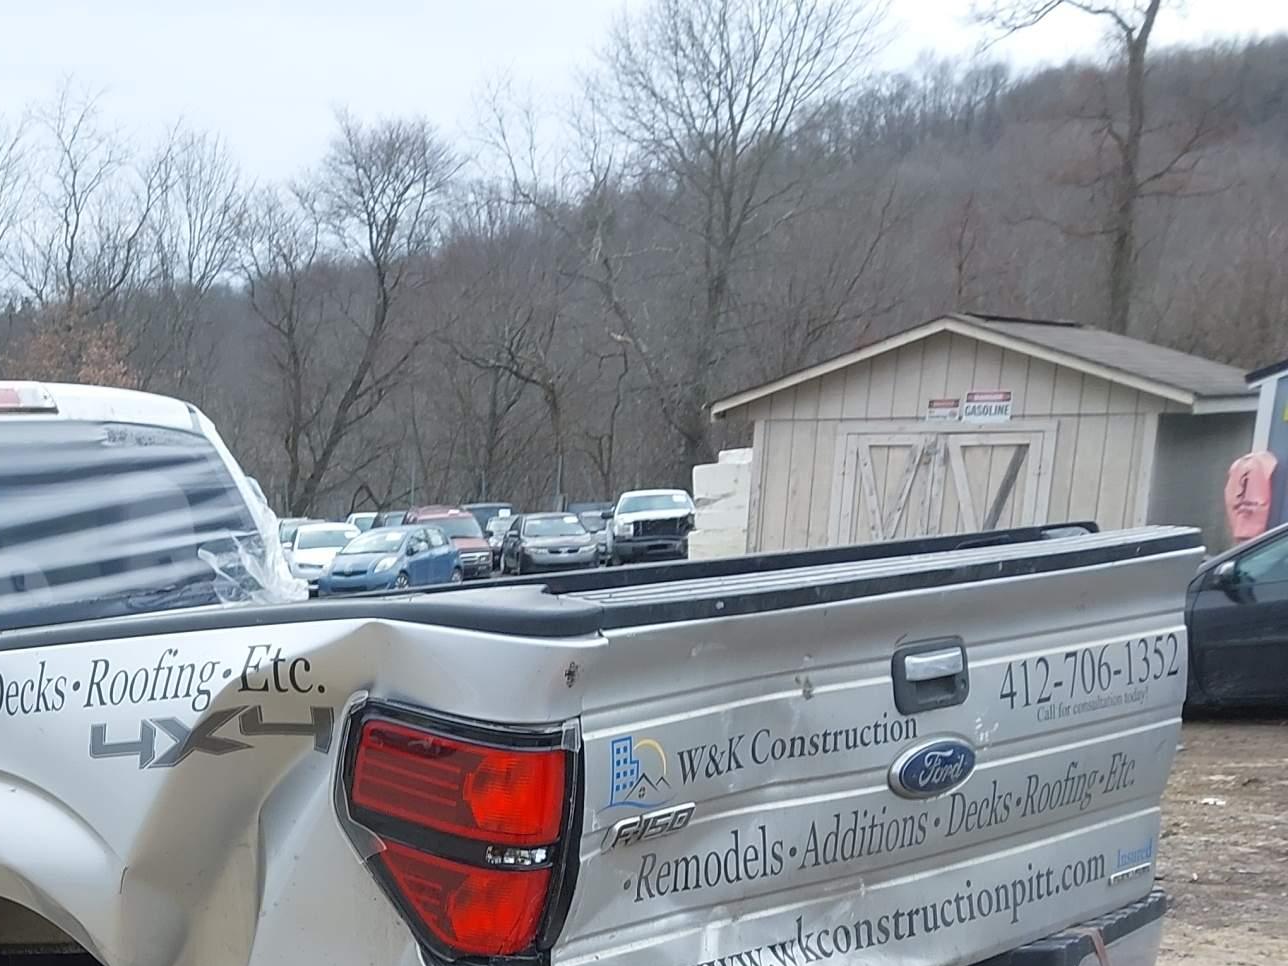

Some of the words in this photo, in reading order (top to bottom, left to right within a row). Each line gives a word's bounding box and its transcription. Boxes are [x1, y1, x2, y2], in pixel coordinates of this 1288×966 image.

[965, 404, 1008, 416] GASOLINE
[238, 644, 325, 694] Etc.
[1000, 632, 1179, 709] 412-706-1352
[677, 733, 745, 785] W&K
[751, 712, 918, 765] Construction
[919, 749, 965, 787] Ford
